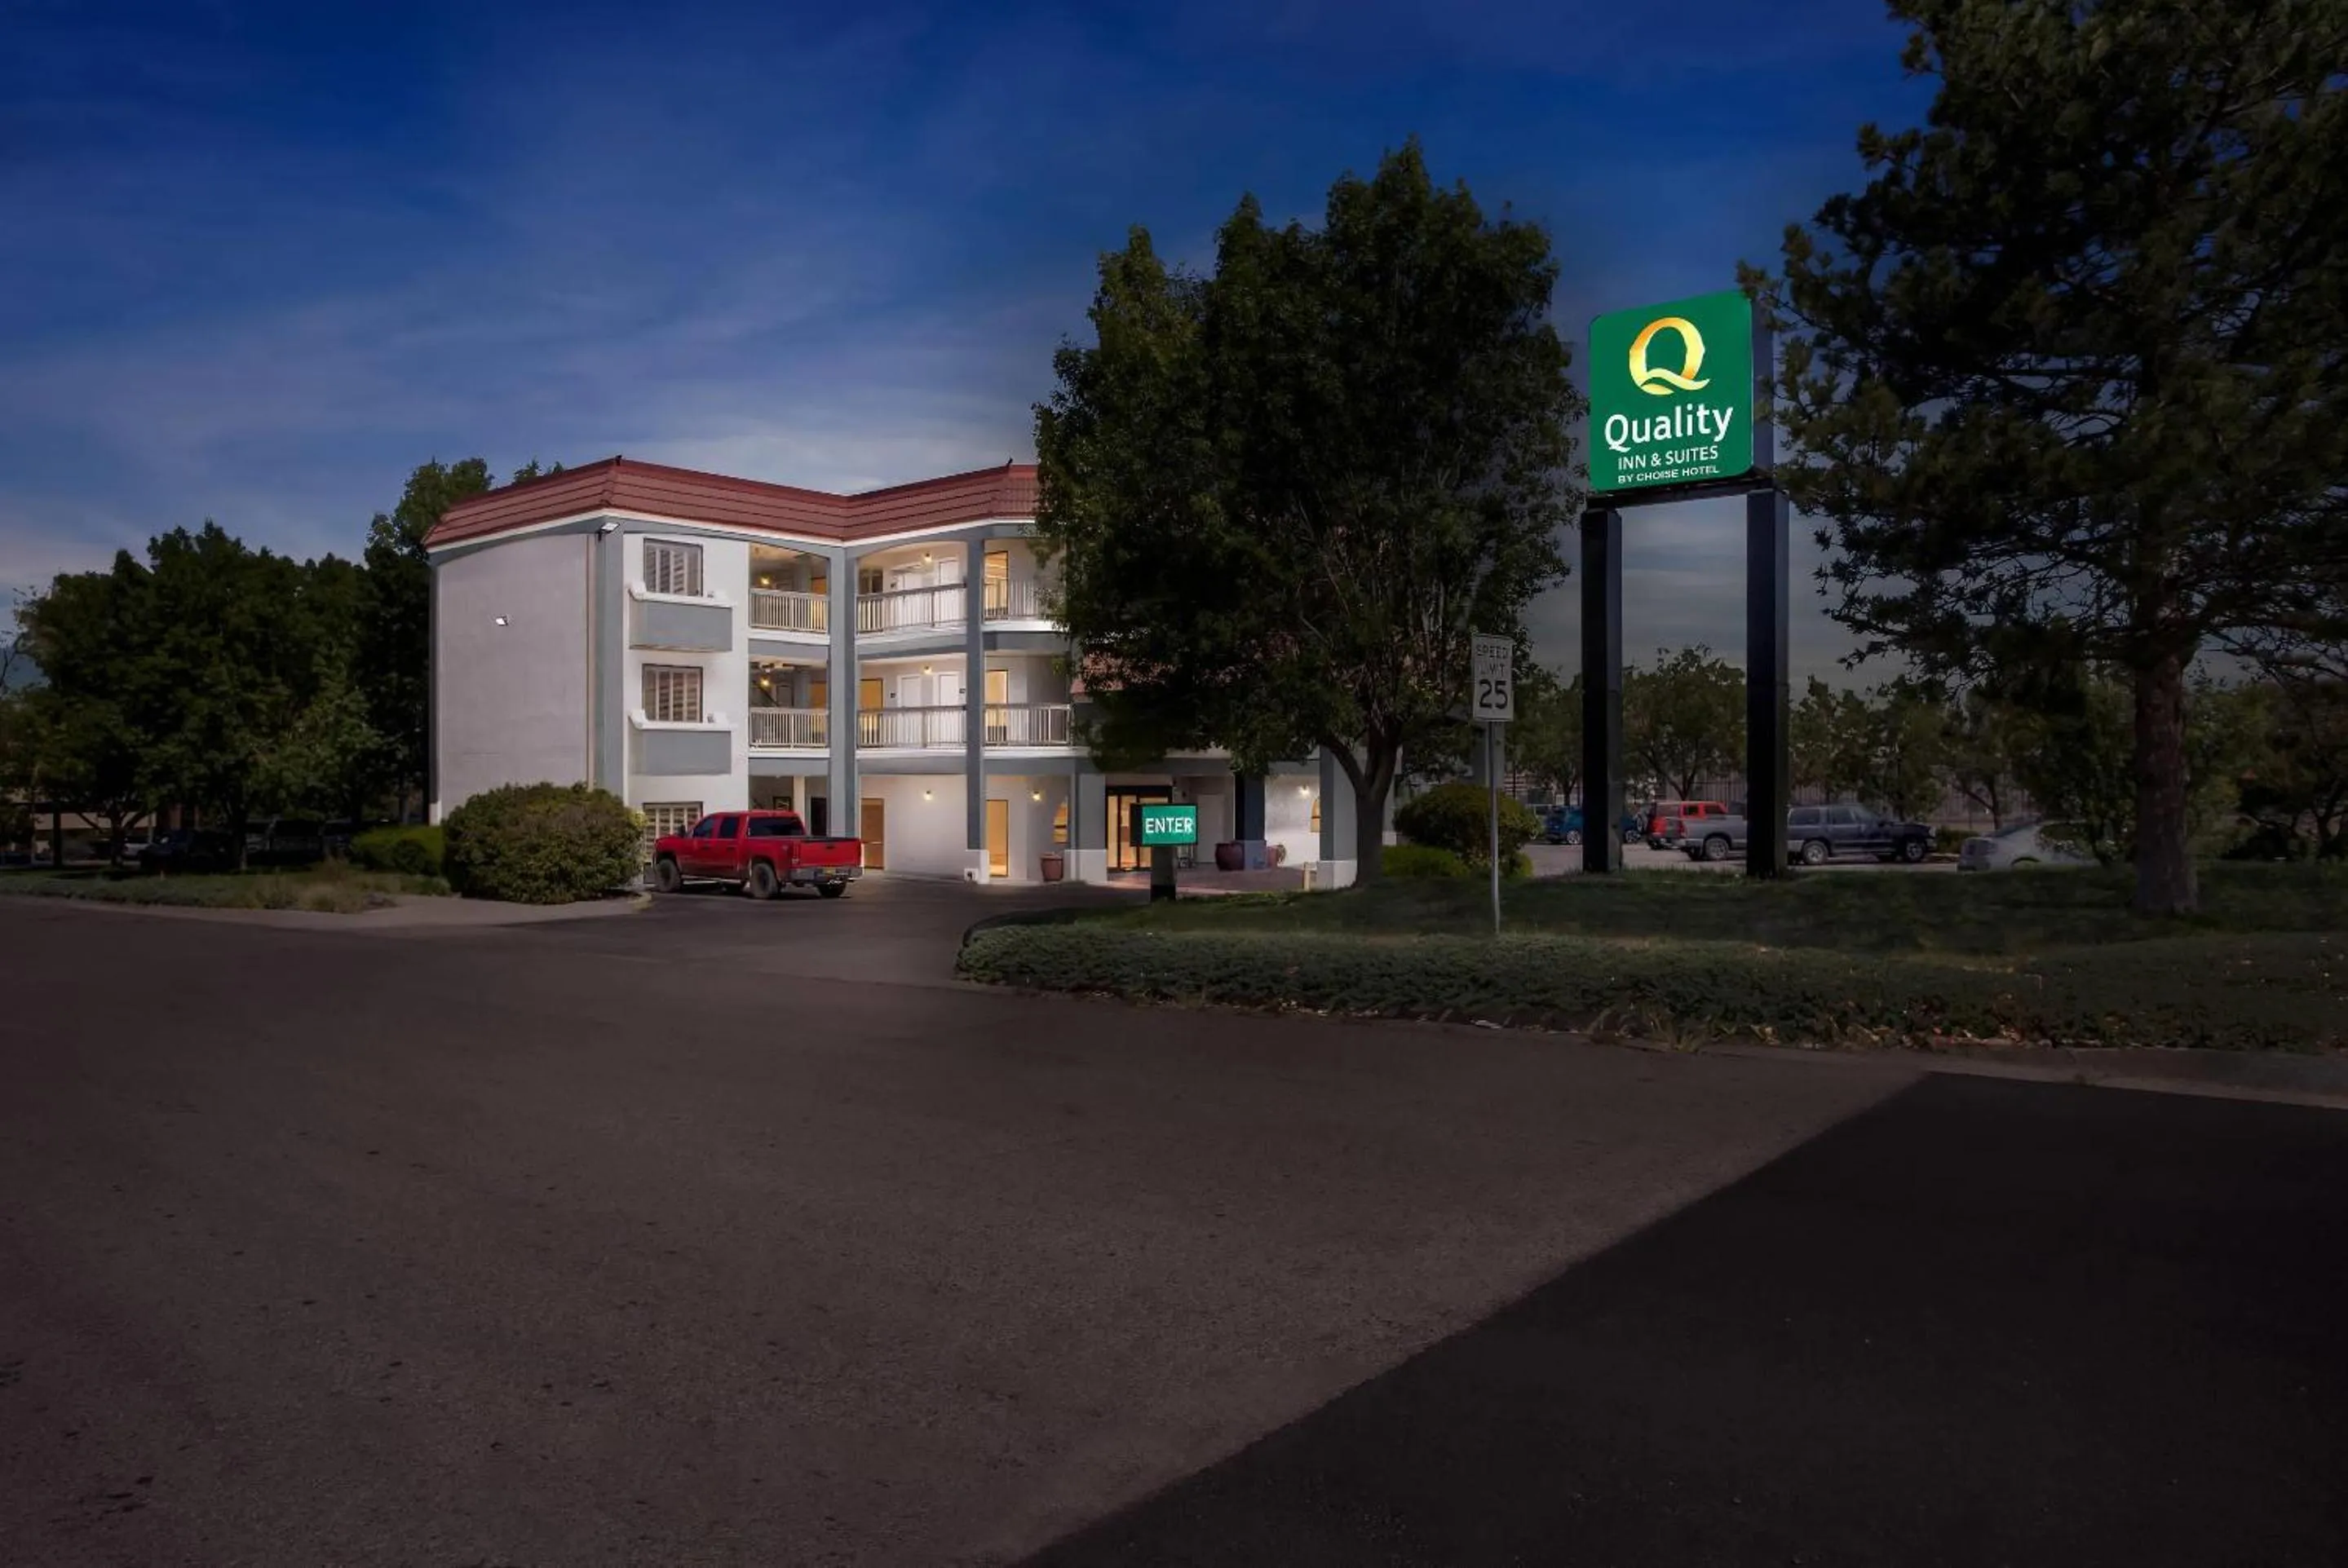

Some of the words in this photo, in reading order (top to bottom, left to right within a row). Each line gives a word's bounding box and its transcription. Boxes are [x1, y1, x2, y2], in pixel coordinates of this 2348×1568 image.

[1629, 316, 1710, 395] Q
[1604, 404, 1733, 453] Quality
[1618, 453, 1646, 470] INN
[1651, 453, 1661, 466] &
[1665, 445, 1718, 466] SUITES
[1618, 474, 1634, 484] BY
[1479, 678, 1508, 709] 25
[1145, 817, 1193, 833] ENTER
